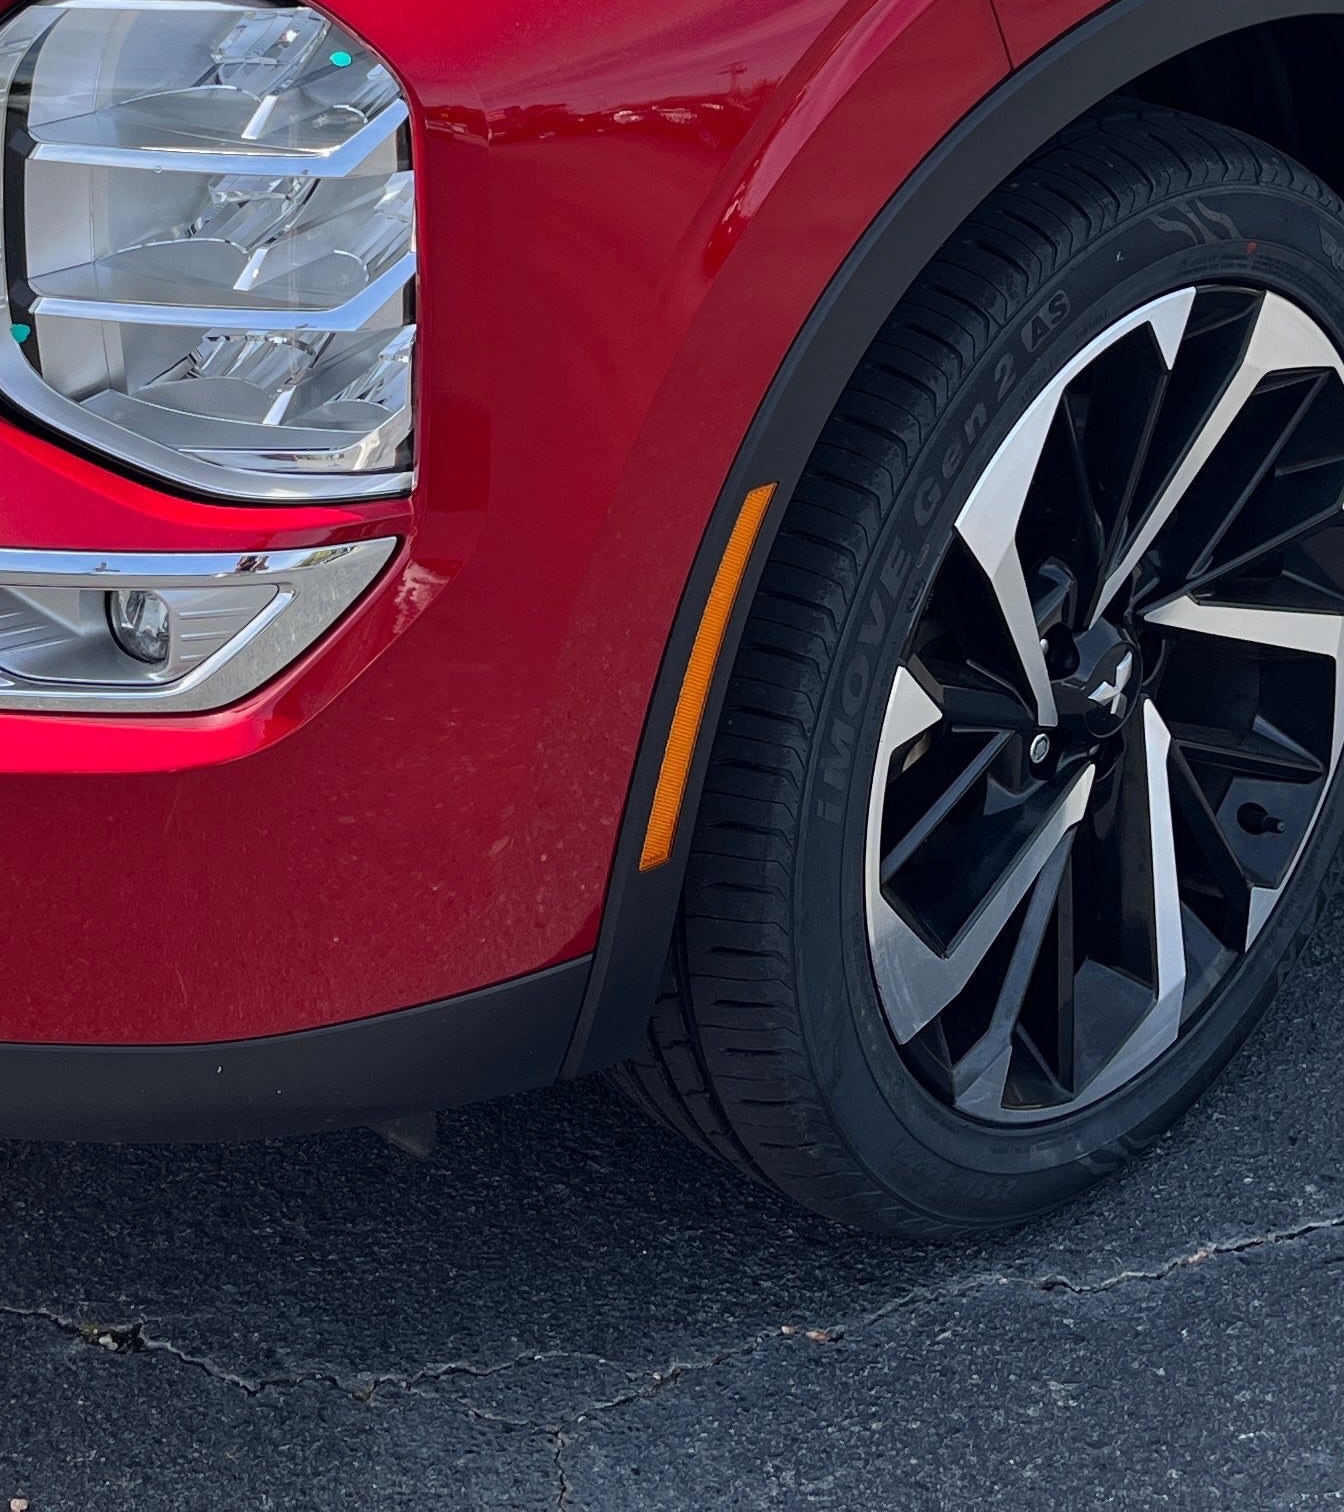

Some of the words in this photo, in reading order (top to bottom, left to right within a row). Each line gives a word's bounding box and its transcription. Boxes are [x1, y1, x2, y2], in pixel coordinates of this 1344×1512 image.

[914, 402, 988, 526] Gen
[994, 352, 1016, 402] 2
[1030, 291, 1069, 341] AS
